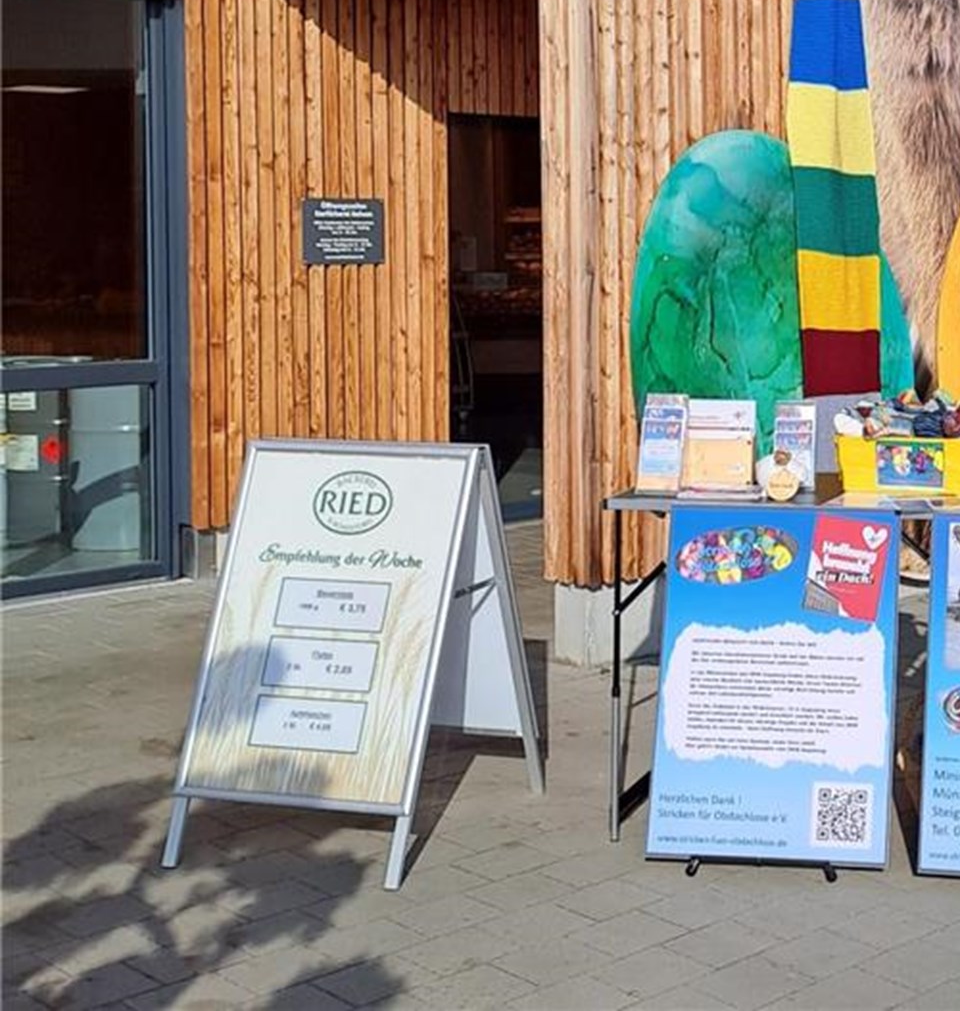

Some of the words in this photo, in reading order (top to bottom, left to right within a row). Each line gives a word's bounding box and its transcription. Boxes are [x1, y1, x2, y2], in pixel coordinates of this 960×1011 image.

[320, 490, 387, 515] RIED
[259, 543, 341, 567] Empfehlung
[344, 552, 365, 565] der
[368, 550, 422, 569] Woche
[658, 793, 709, 805] Herzlichen
[711, 794, 735, 805] Dank
[657, 808, 696, 819] Stricken
[698, 809, 712, 821] für
[713, 810, 769, 822] Obdachlose
